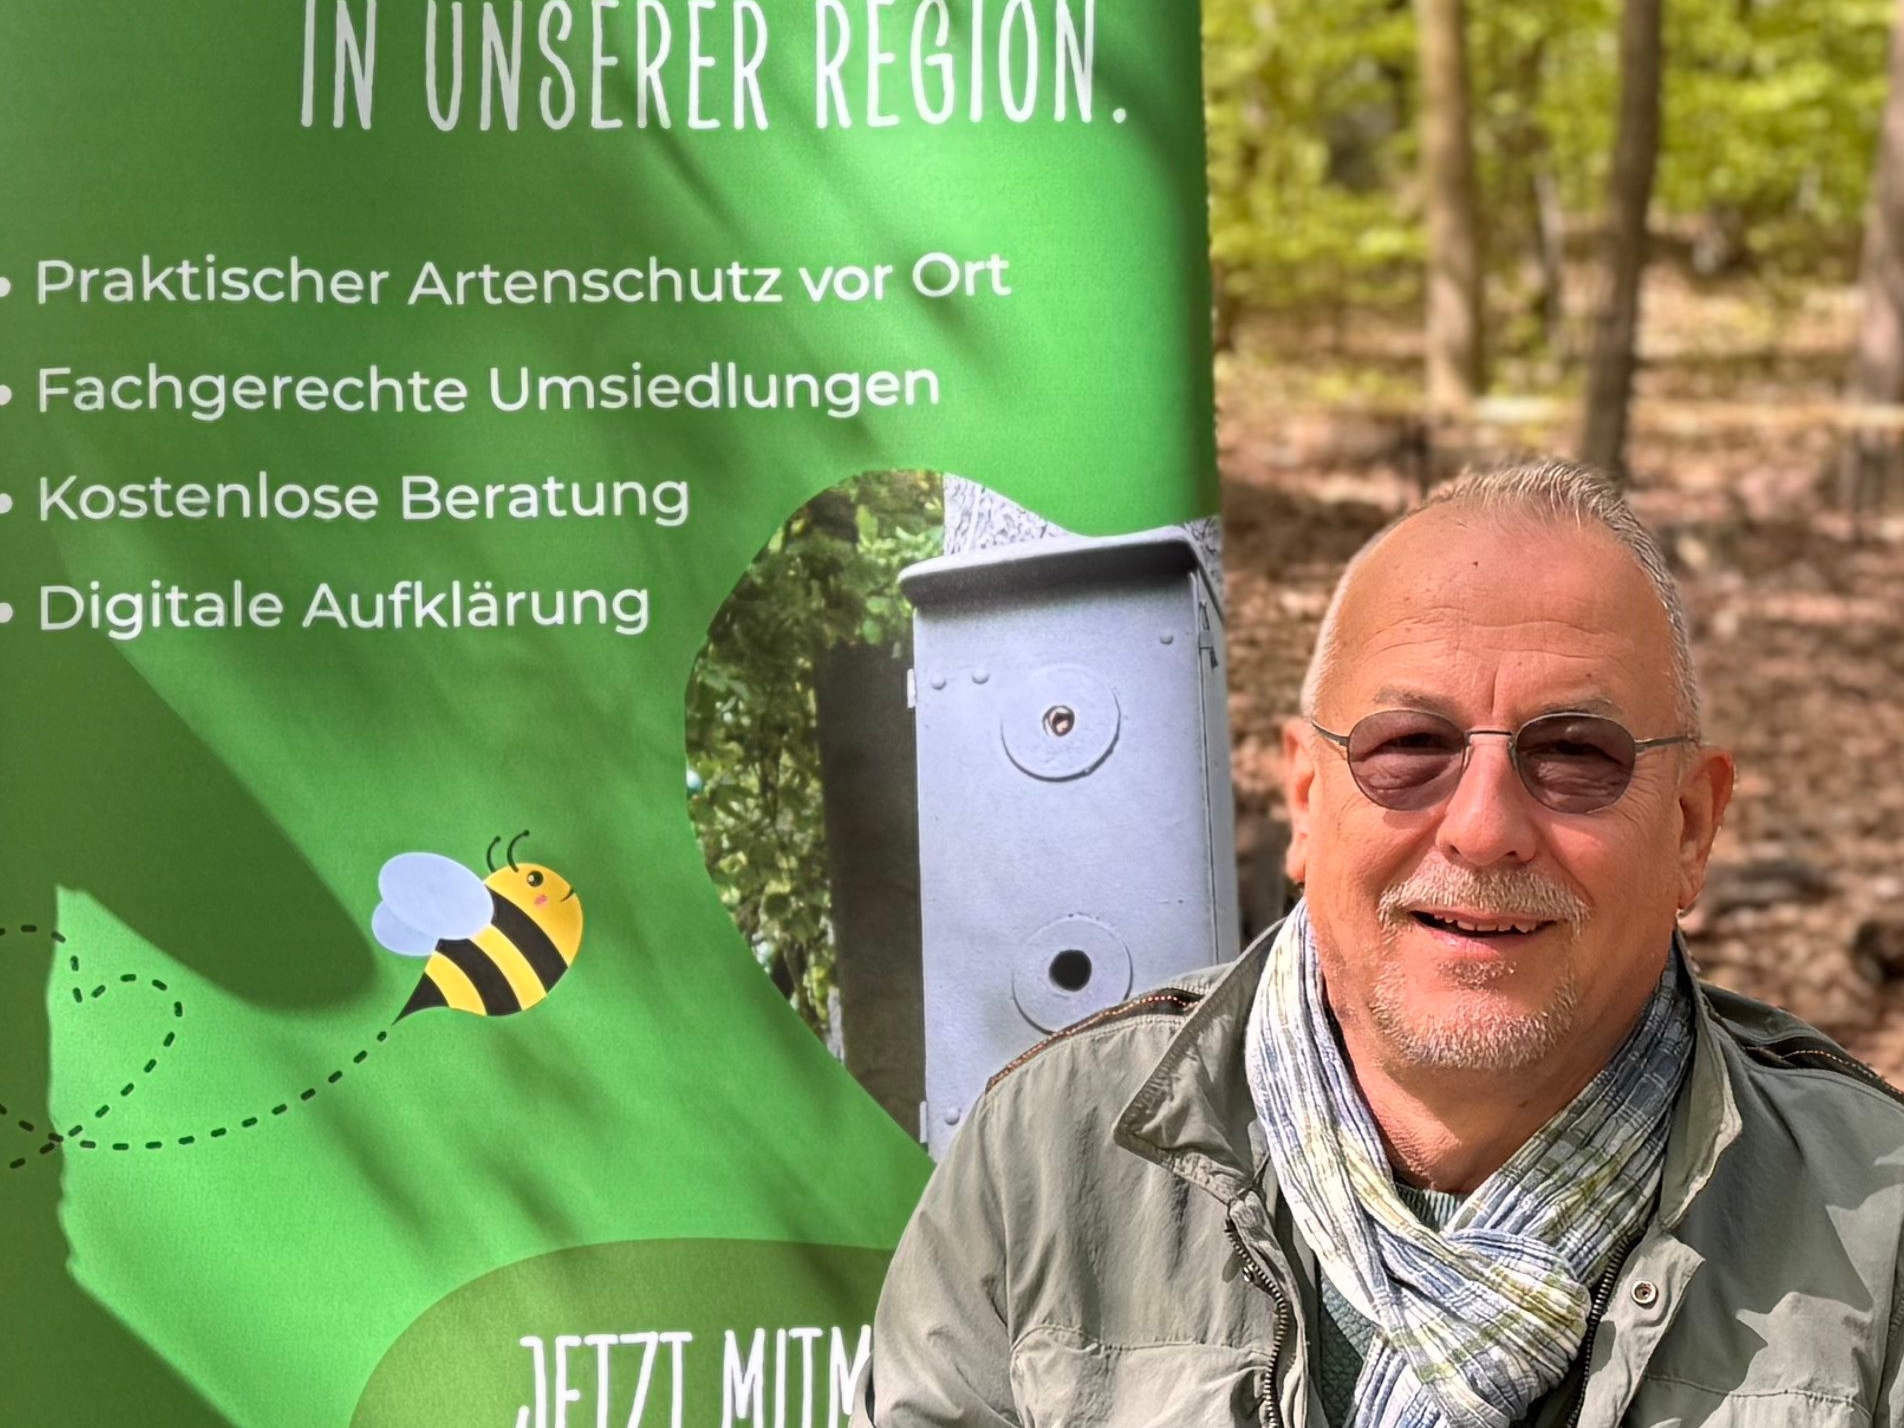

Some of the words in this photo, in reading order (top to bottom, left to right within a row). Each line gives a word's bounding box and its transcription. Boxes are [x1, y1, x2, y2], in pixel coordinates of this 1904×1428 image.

[37, 252, 391, 306] Praktischer
[407, 255, 784, 306] Artenschutz
[798, 264, 894, 303] vor
[912, 251, 1013, 298] Ort
[38, 361, 469, 423] Fachgerechte
[489, 361, 941, 419] Umsiedlungen
[39, 470, 380, 522] Kostenlose
[401, 474, 690, 528] Beratung
[39, 578, 285, 642] Digitale
[301, 579, 650, 636] Aufklärung
